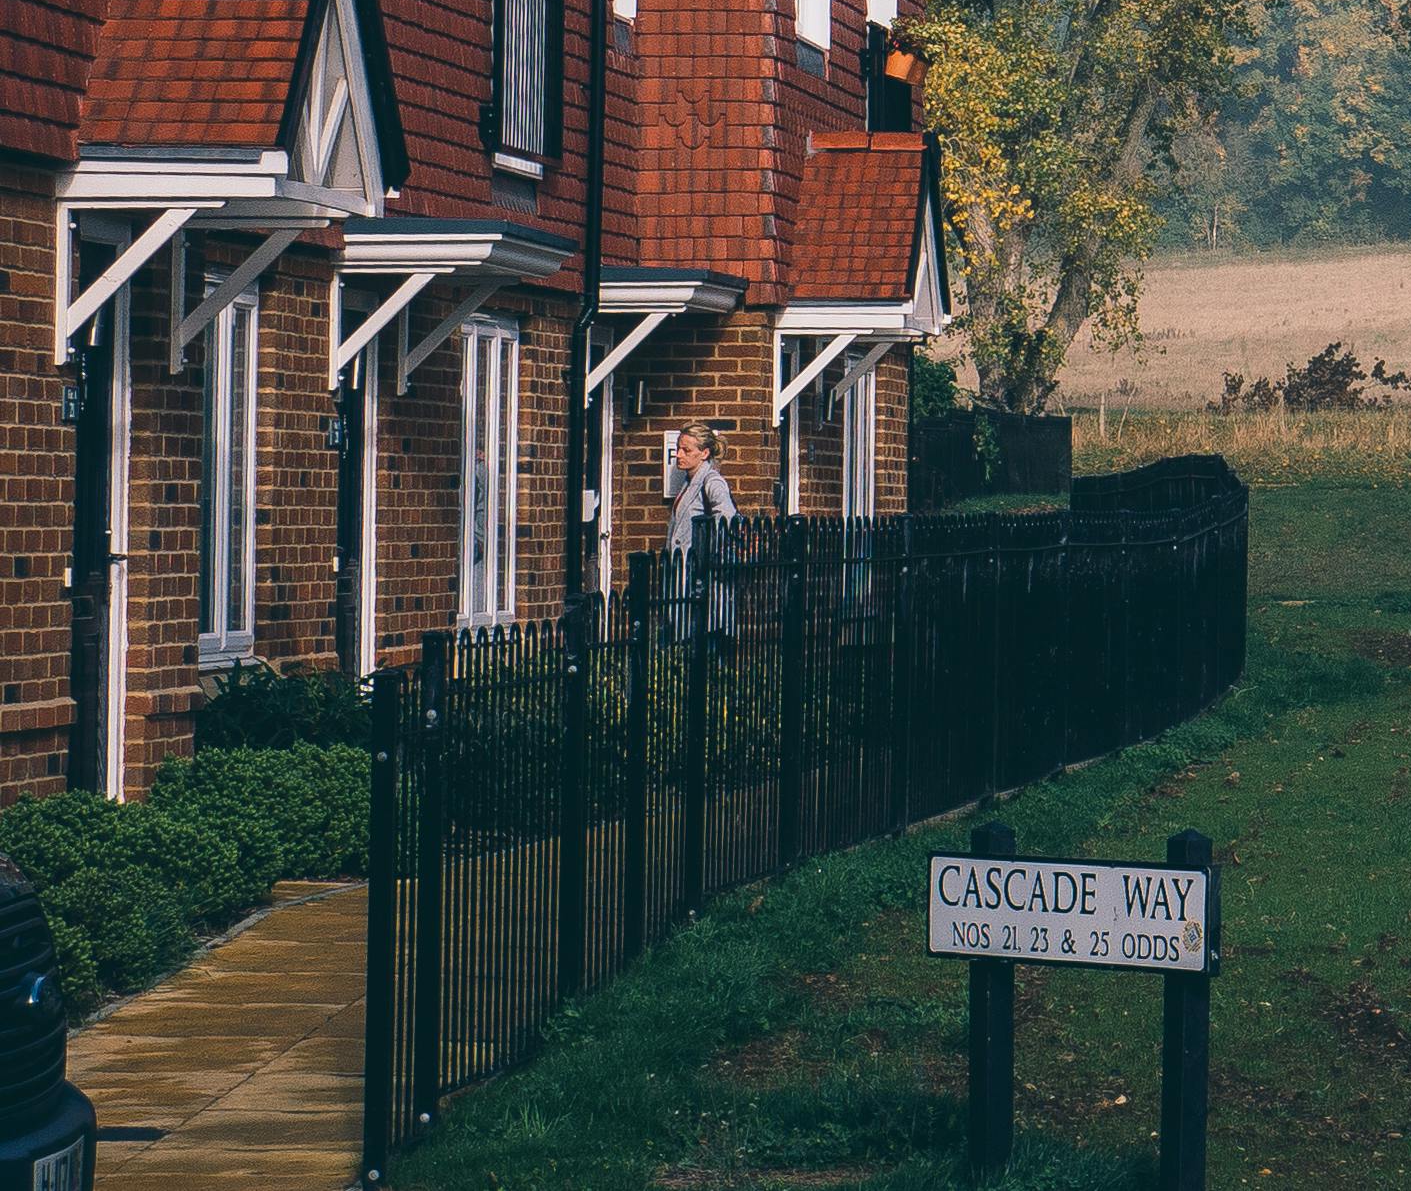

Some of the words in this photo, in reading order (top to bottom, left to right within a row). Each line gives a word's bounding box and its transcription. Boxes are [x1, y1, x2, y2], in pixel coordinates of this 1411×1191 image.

[938, 865, 1097, 915] CASCADE
[1122, 874, 1194, 922] WAY
[952, 921, 991, 950] NOS
[1002, 925, 1022, 953] 21,
[1030, 926, 1049, 953] 23
[1061, 928, 1077, 955] &
[1089, 930, 1110, 957] 25
[1121, 932, 1180, 963] ODDS
